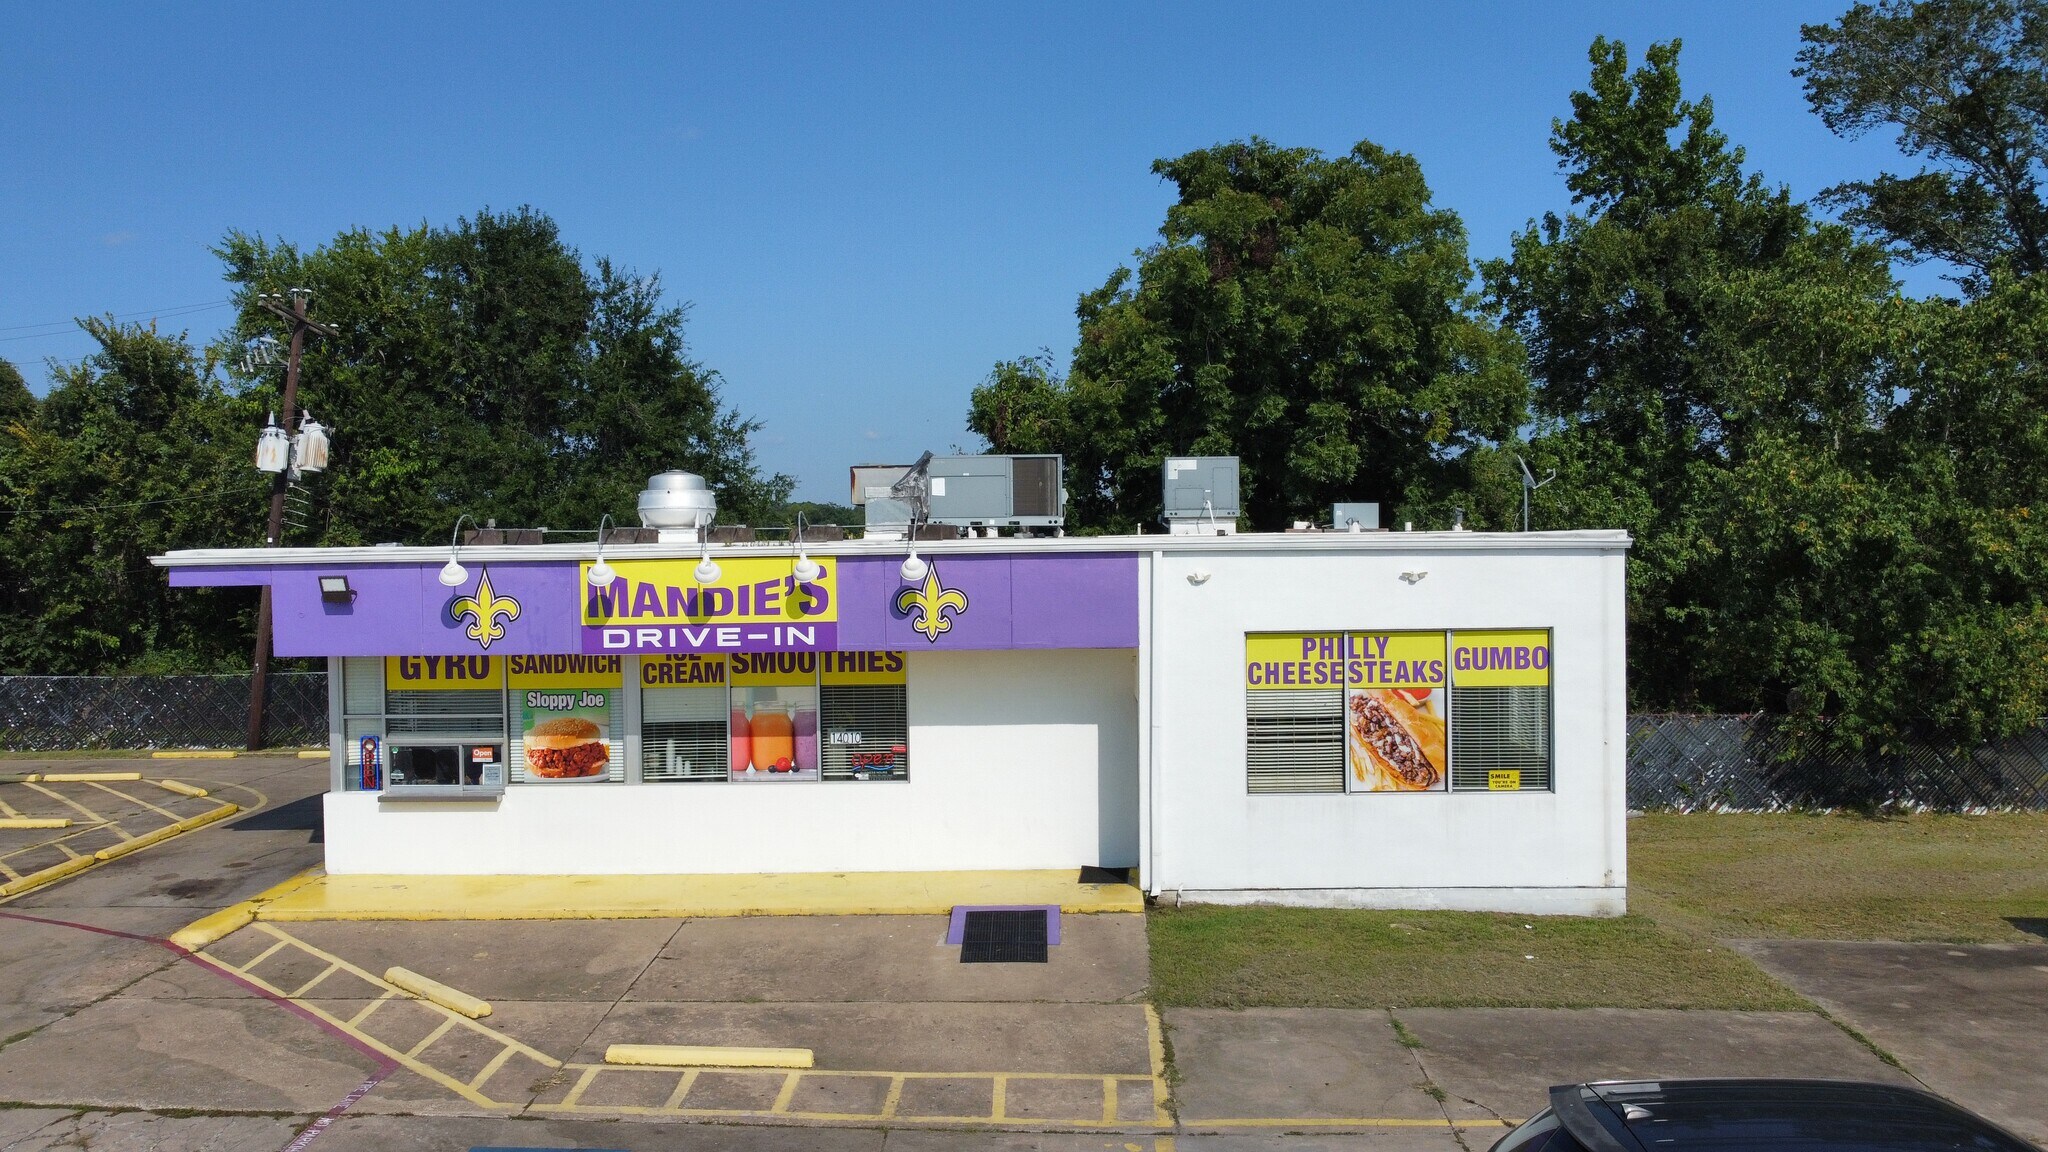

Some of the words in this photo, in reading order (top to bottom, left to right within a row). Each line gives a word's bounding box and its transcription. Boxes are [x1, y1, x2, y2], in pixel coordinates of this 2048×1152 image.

[587, 565, 829, 618] MANDIE'S
[603, 627, 815, 649] DRIVE-IN
[1302, 636, 1390, 660] PHILLY
[400, 655, 490, 680] GYRO
[511, 654, 621, 674] SANDWICH
[1454, 646, 1548, 671] GUMBO
[643, 662, 724, 684] CREAM
[527, 691, 576, 710] Sloppy
[579, 691, 605, 707] Joe
[831, 732, 861, 744] 14010
[363, 738, 377, 788] OPEN
[473, 749, 492, 758] Open
